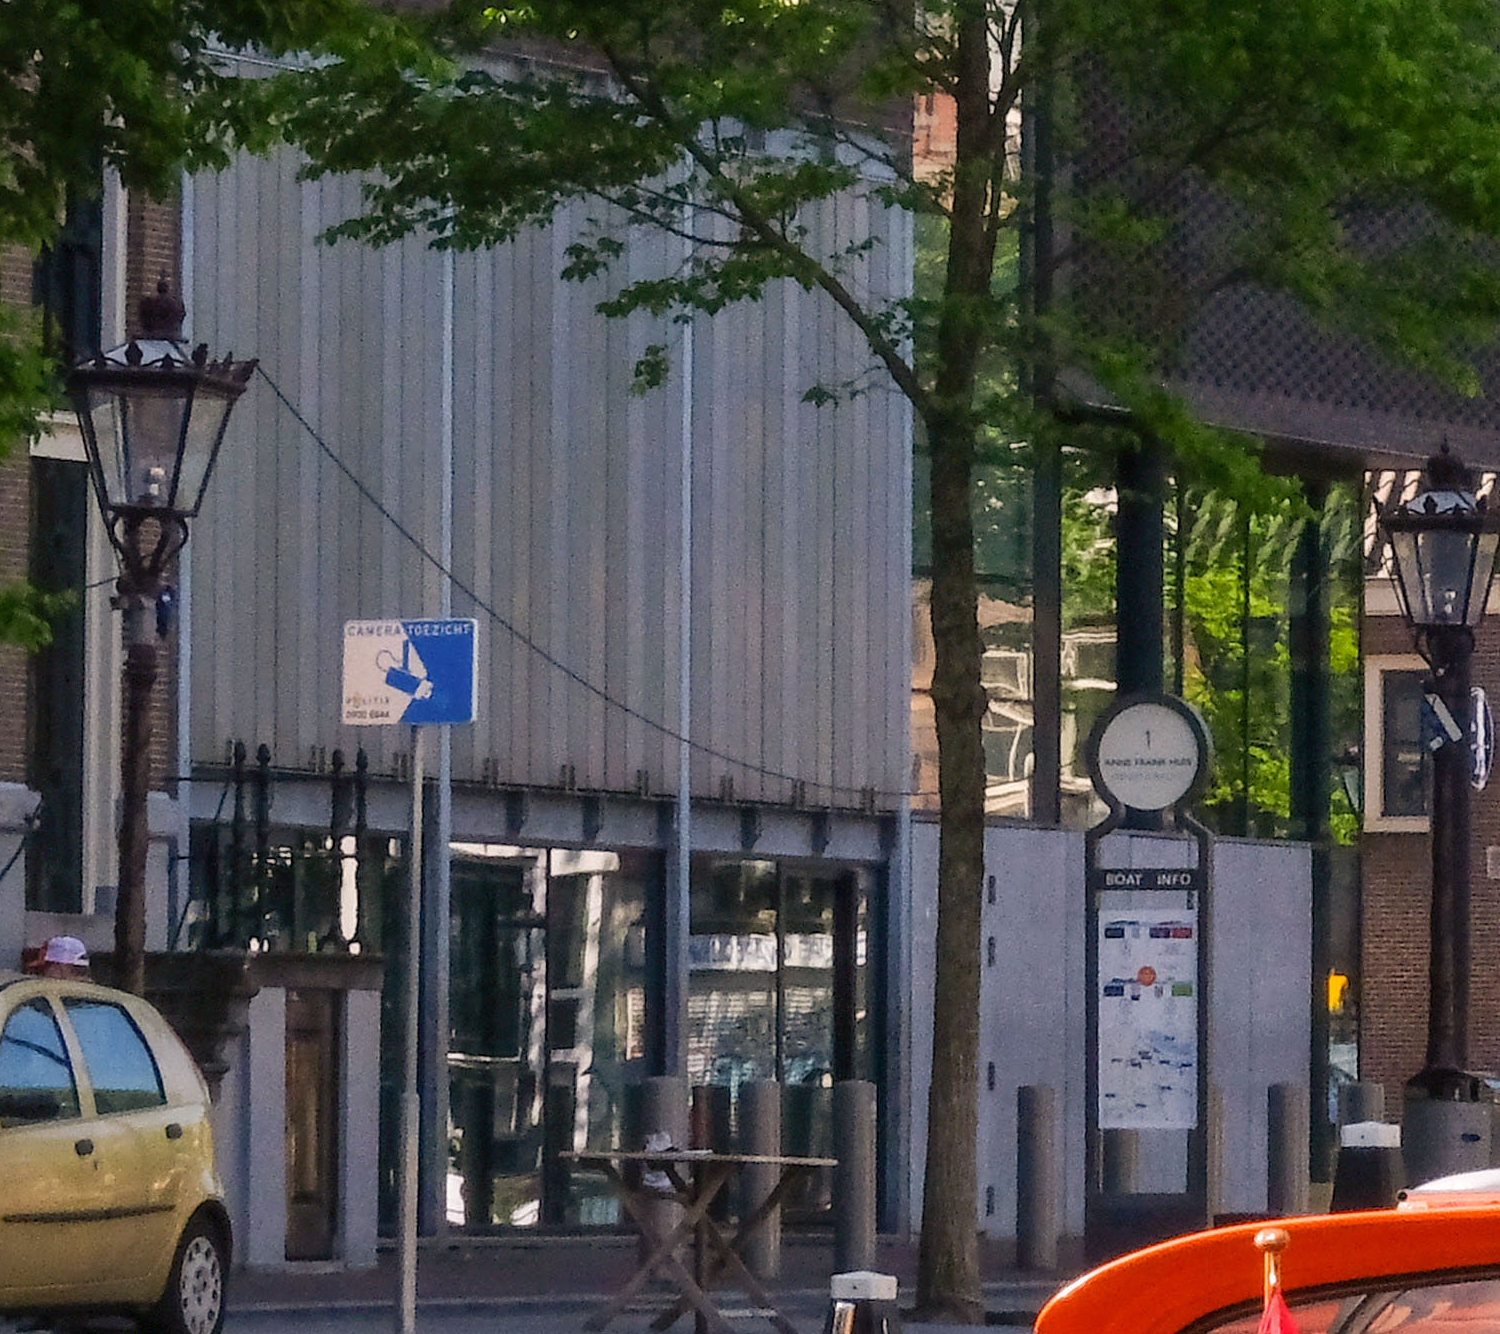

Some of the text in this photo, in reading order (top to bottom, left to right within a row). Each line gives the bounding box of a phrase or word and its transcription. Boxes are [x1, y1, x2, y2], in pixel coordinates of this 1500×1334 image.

[346, 623, 471, 637] CAMERA TOEZICHT
[1105, 873, 1191, 886] BOAT INFO
